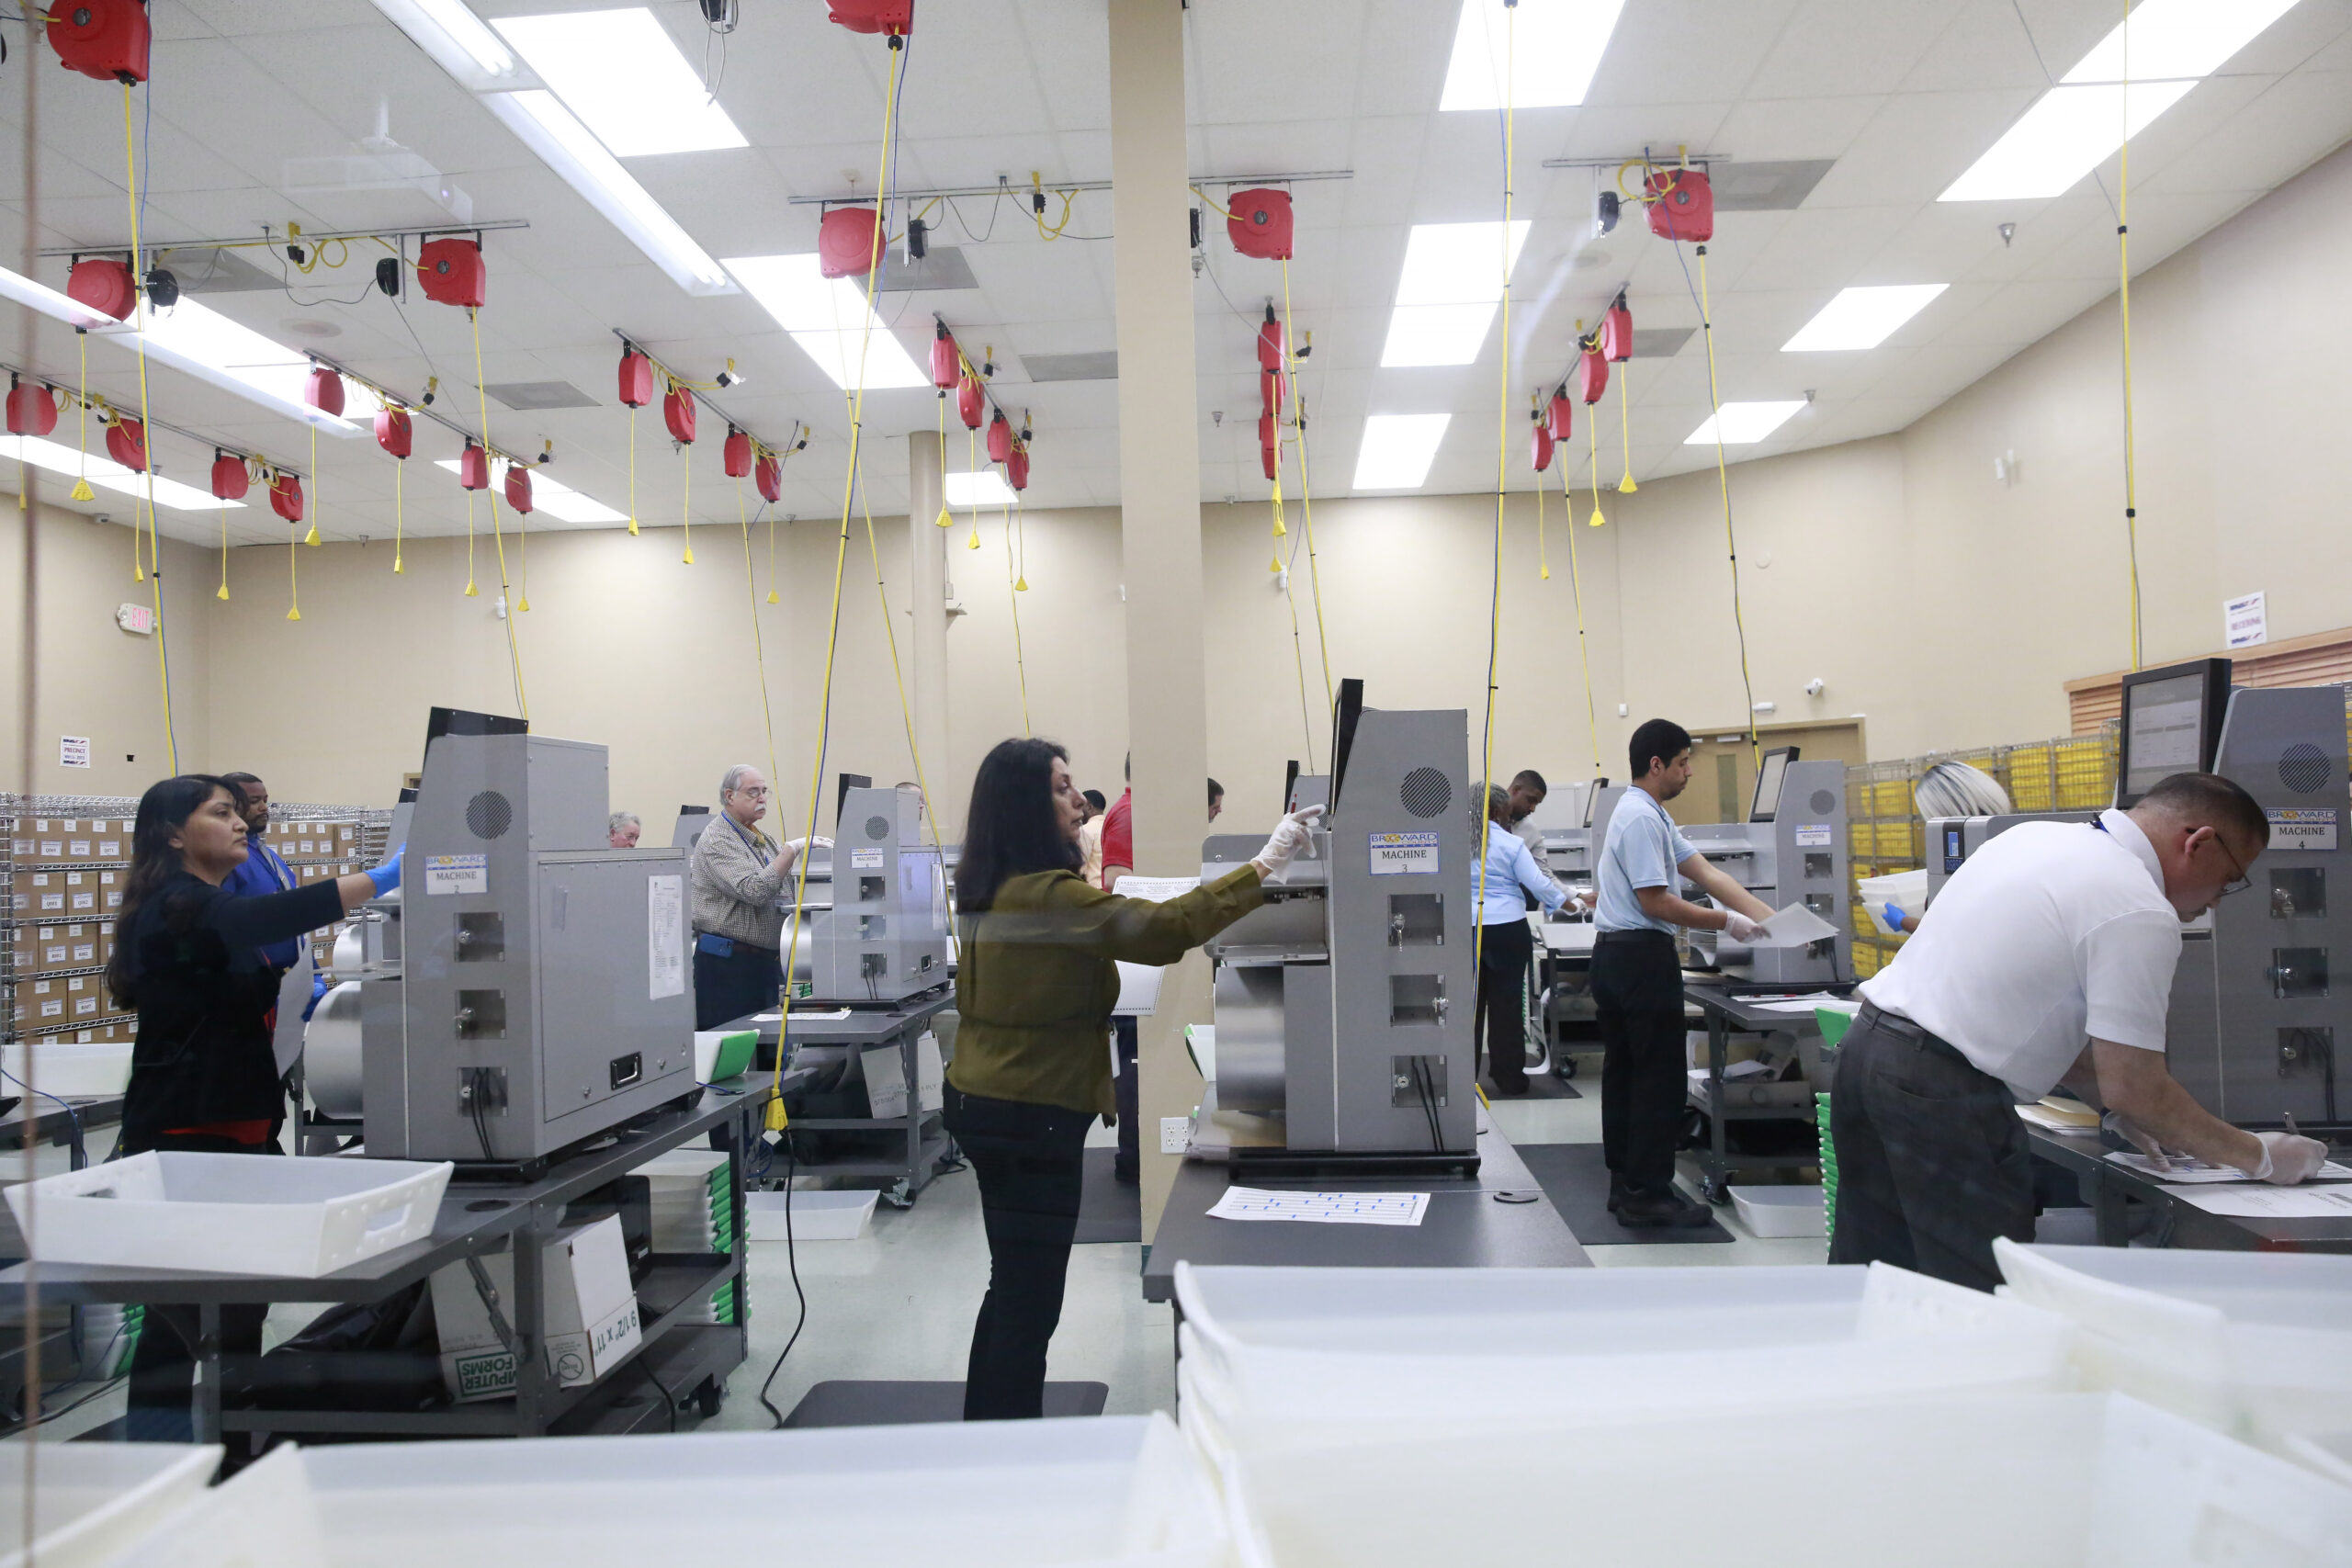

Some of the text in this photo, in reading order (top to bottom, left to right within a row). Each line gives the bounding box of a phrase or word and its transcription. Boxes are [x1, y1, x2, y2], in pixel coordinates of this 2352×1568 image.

[132, 607, 150, 628] EXIT
[2268, 810, 2336, 819] BROWARD
[2279, 827, 2325, 836] MACHINE
[1371, 833, 1437, 843] BROWARD
[2299, 840, 2305, 850] 4
[1382, 850, 1427, 860] MACHINE
[1402, 864, 1408, 874] 3
[436, 871, 477, 881] MACHINE
[631, 1310, 637, 1327] 9
[462, 1356, 513, 1376] FORMS
